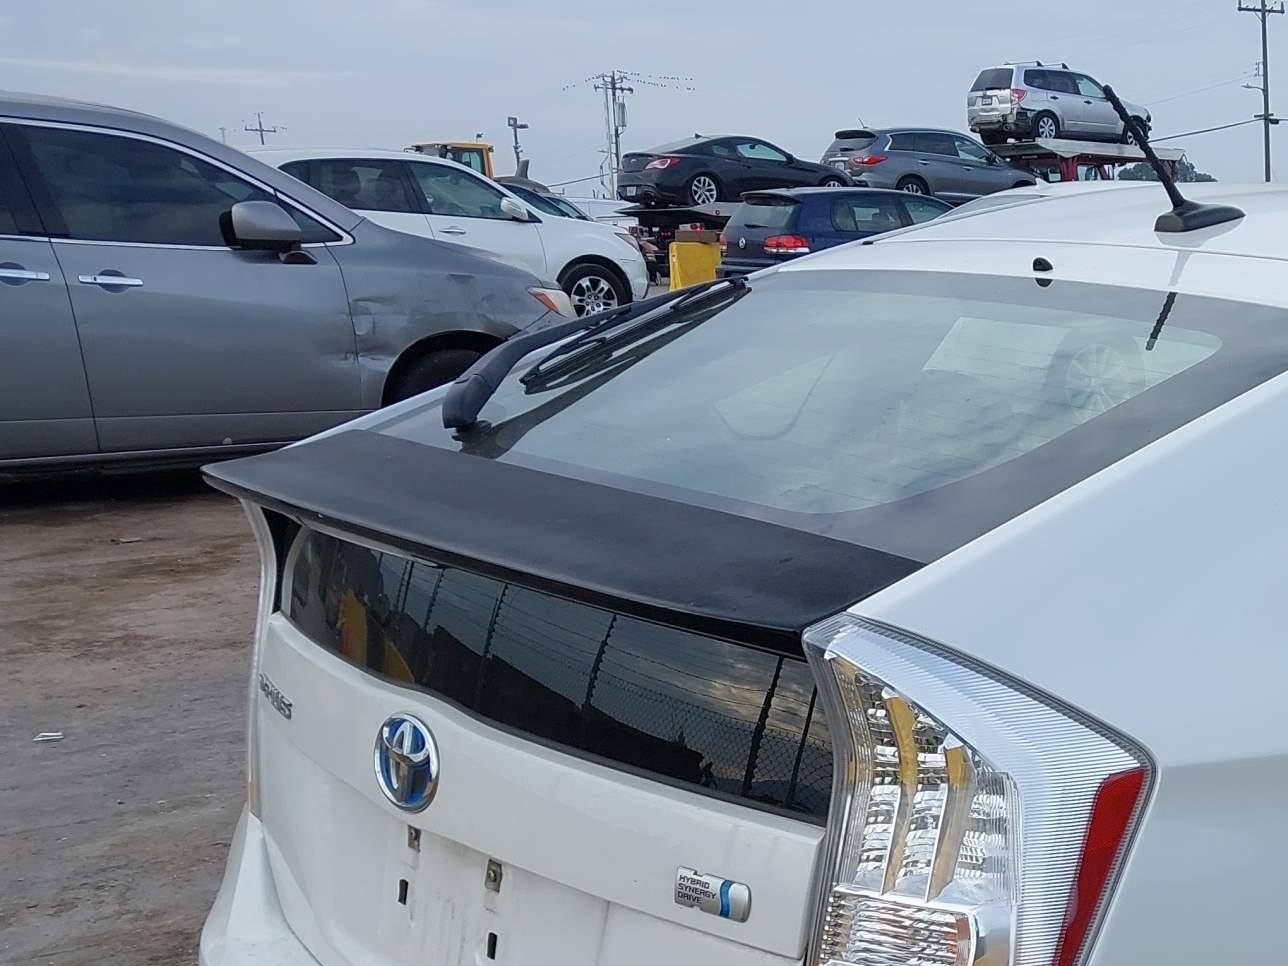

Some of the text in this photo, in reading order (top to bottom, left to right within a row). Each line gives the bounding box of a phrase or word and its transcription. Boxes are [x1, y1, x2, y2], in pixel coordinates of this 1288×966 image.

[678, 874, 711, 890] HYBRID
[677, 882, 717, 900] SYNERGY
[677, 890, 703, 904] DRIVE
